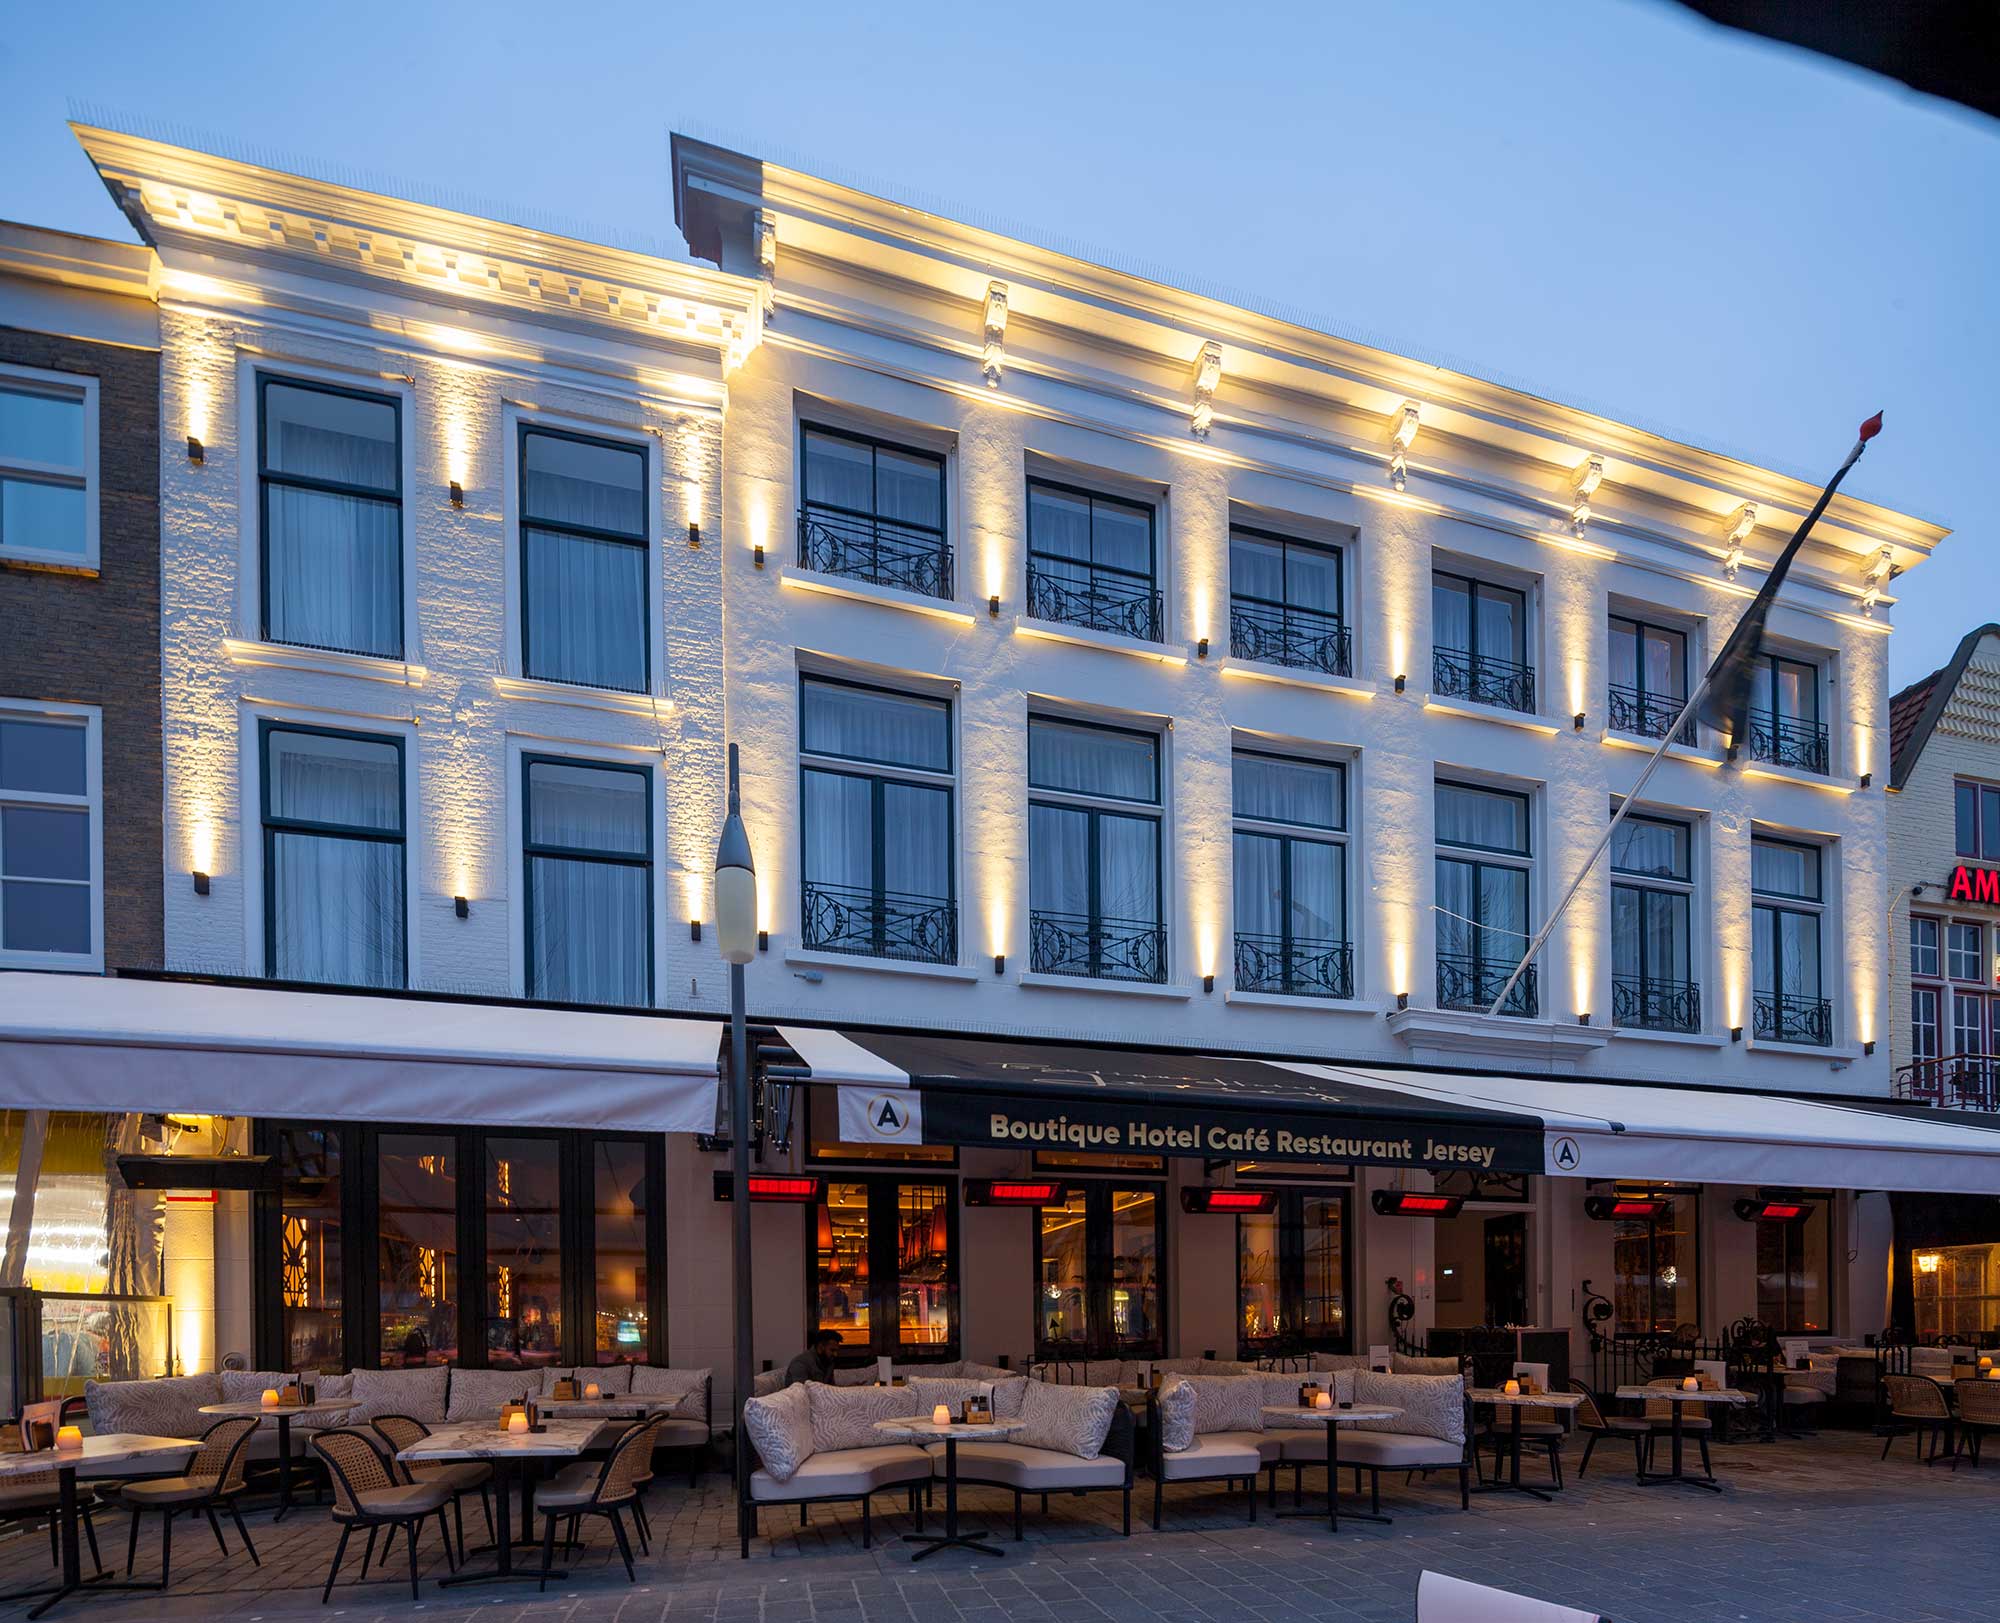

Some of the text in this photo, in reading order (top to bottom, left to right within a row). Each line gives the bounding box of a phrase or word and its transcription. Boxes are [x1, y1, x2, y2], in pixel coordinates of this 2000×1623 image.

[876, 1099, 901, 1128] A
[990, 1114, 1495, 1167] Boutique Hotel Café Restaurant Jersey
[1558, 1140, 1575, 1164] A
